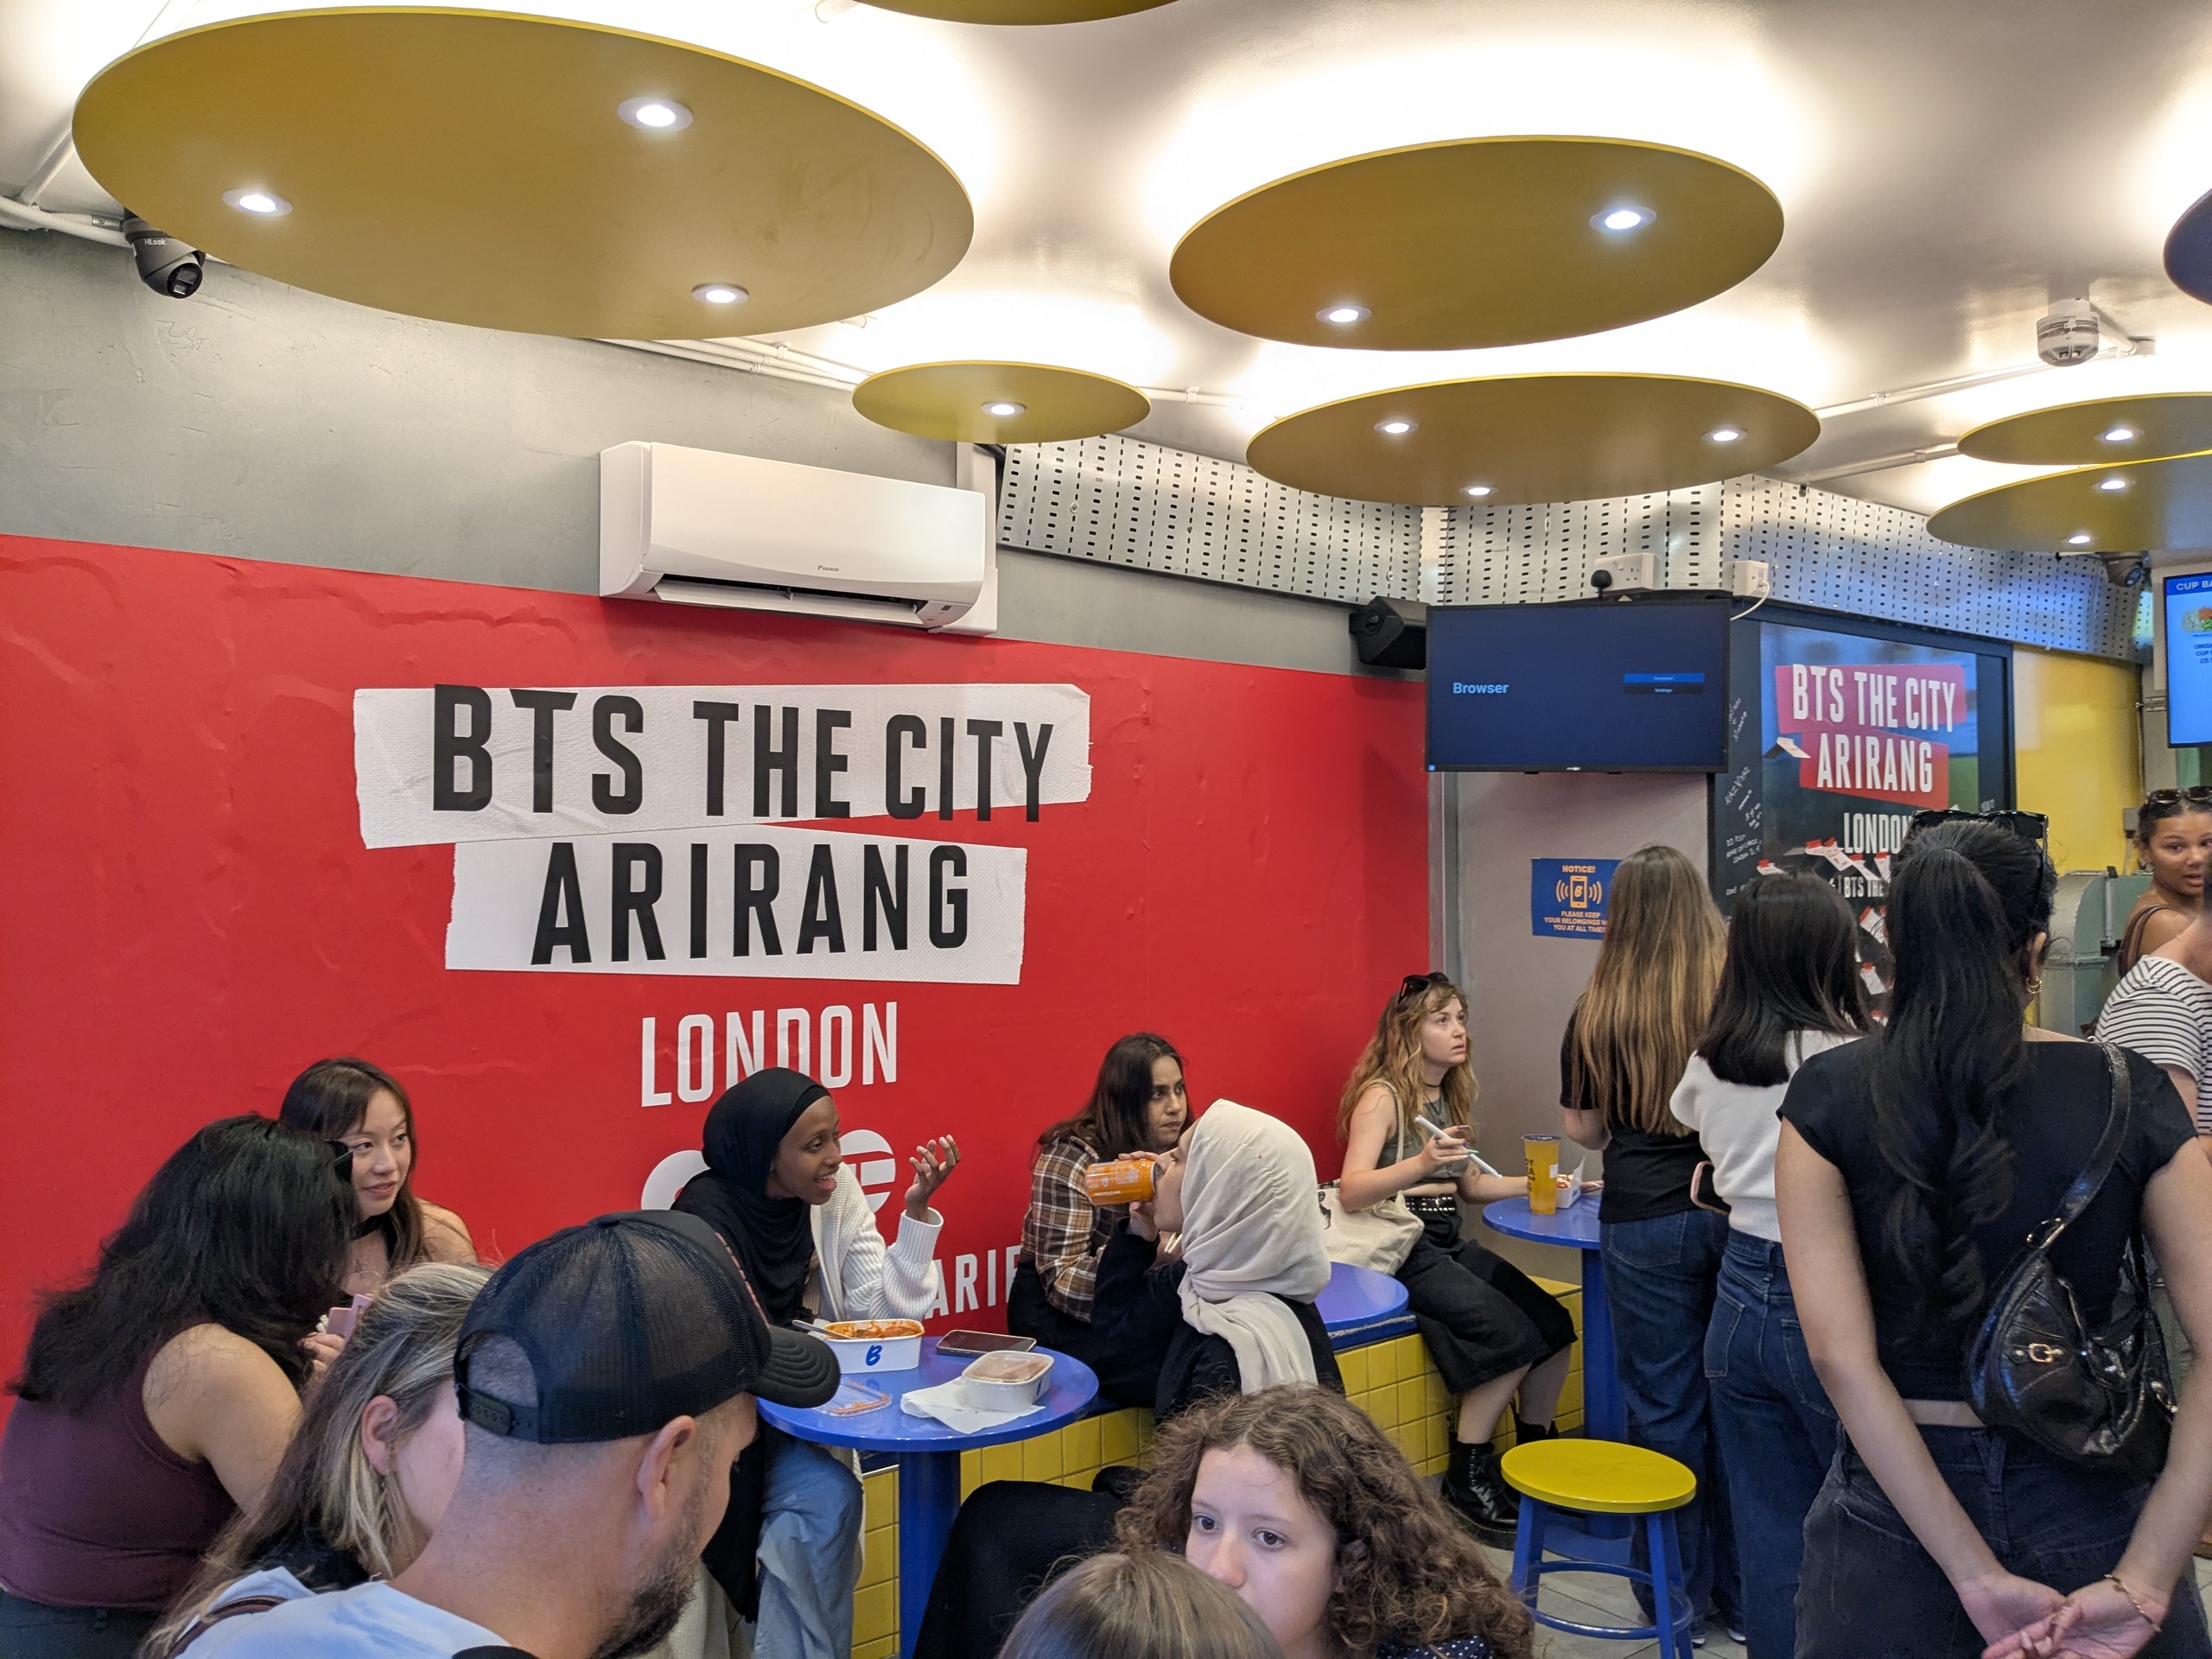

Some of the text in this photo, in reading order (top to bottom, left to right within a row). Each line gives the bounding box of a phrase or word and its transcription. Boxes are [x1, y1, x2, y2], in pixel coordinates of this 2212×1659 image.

[2176, 582, 2199, 591] CUP
[1452, 682, 1510, 694] Browser
[1793, 664, 1844, 723] BTS
[1854, 671, 1898, 728] THE
[1905, 677, 1955, 733] CITY
[432, 683, 1054, 823] BTS THE CITY
[1816, 733, 1933, 793] ARIRANG
[531, 842, 969, 965] ARIRANG
[1843, 876, 1865, 898] BTS
[641, 1001, 897, 1107] LONDON
